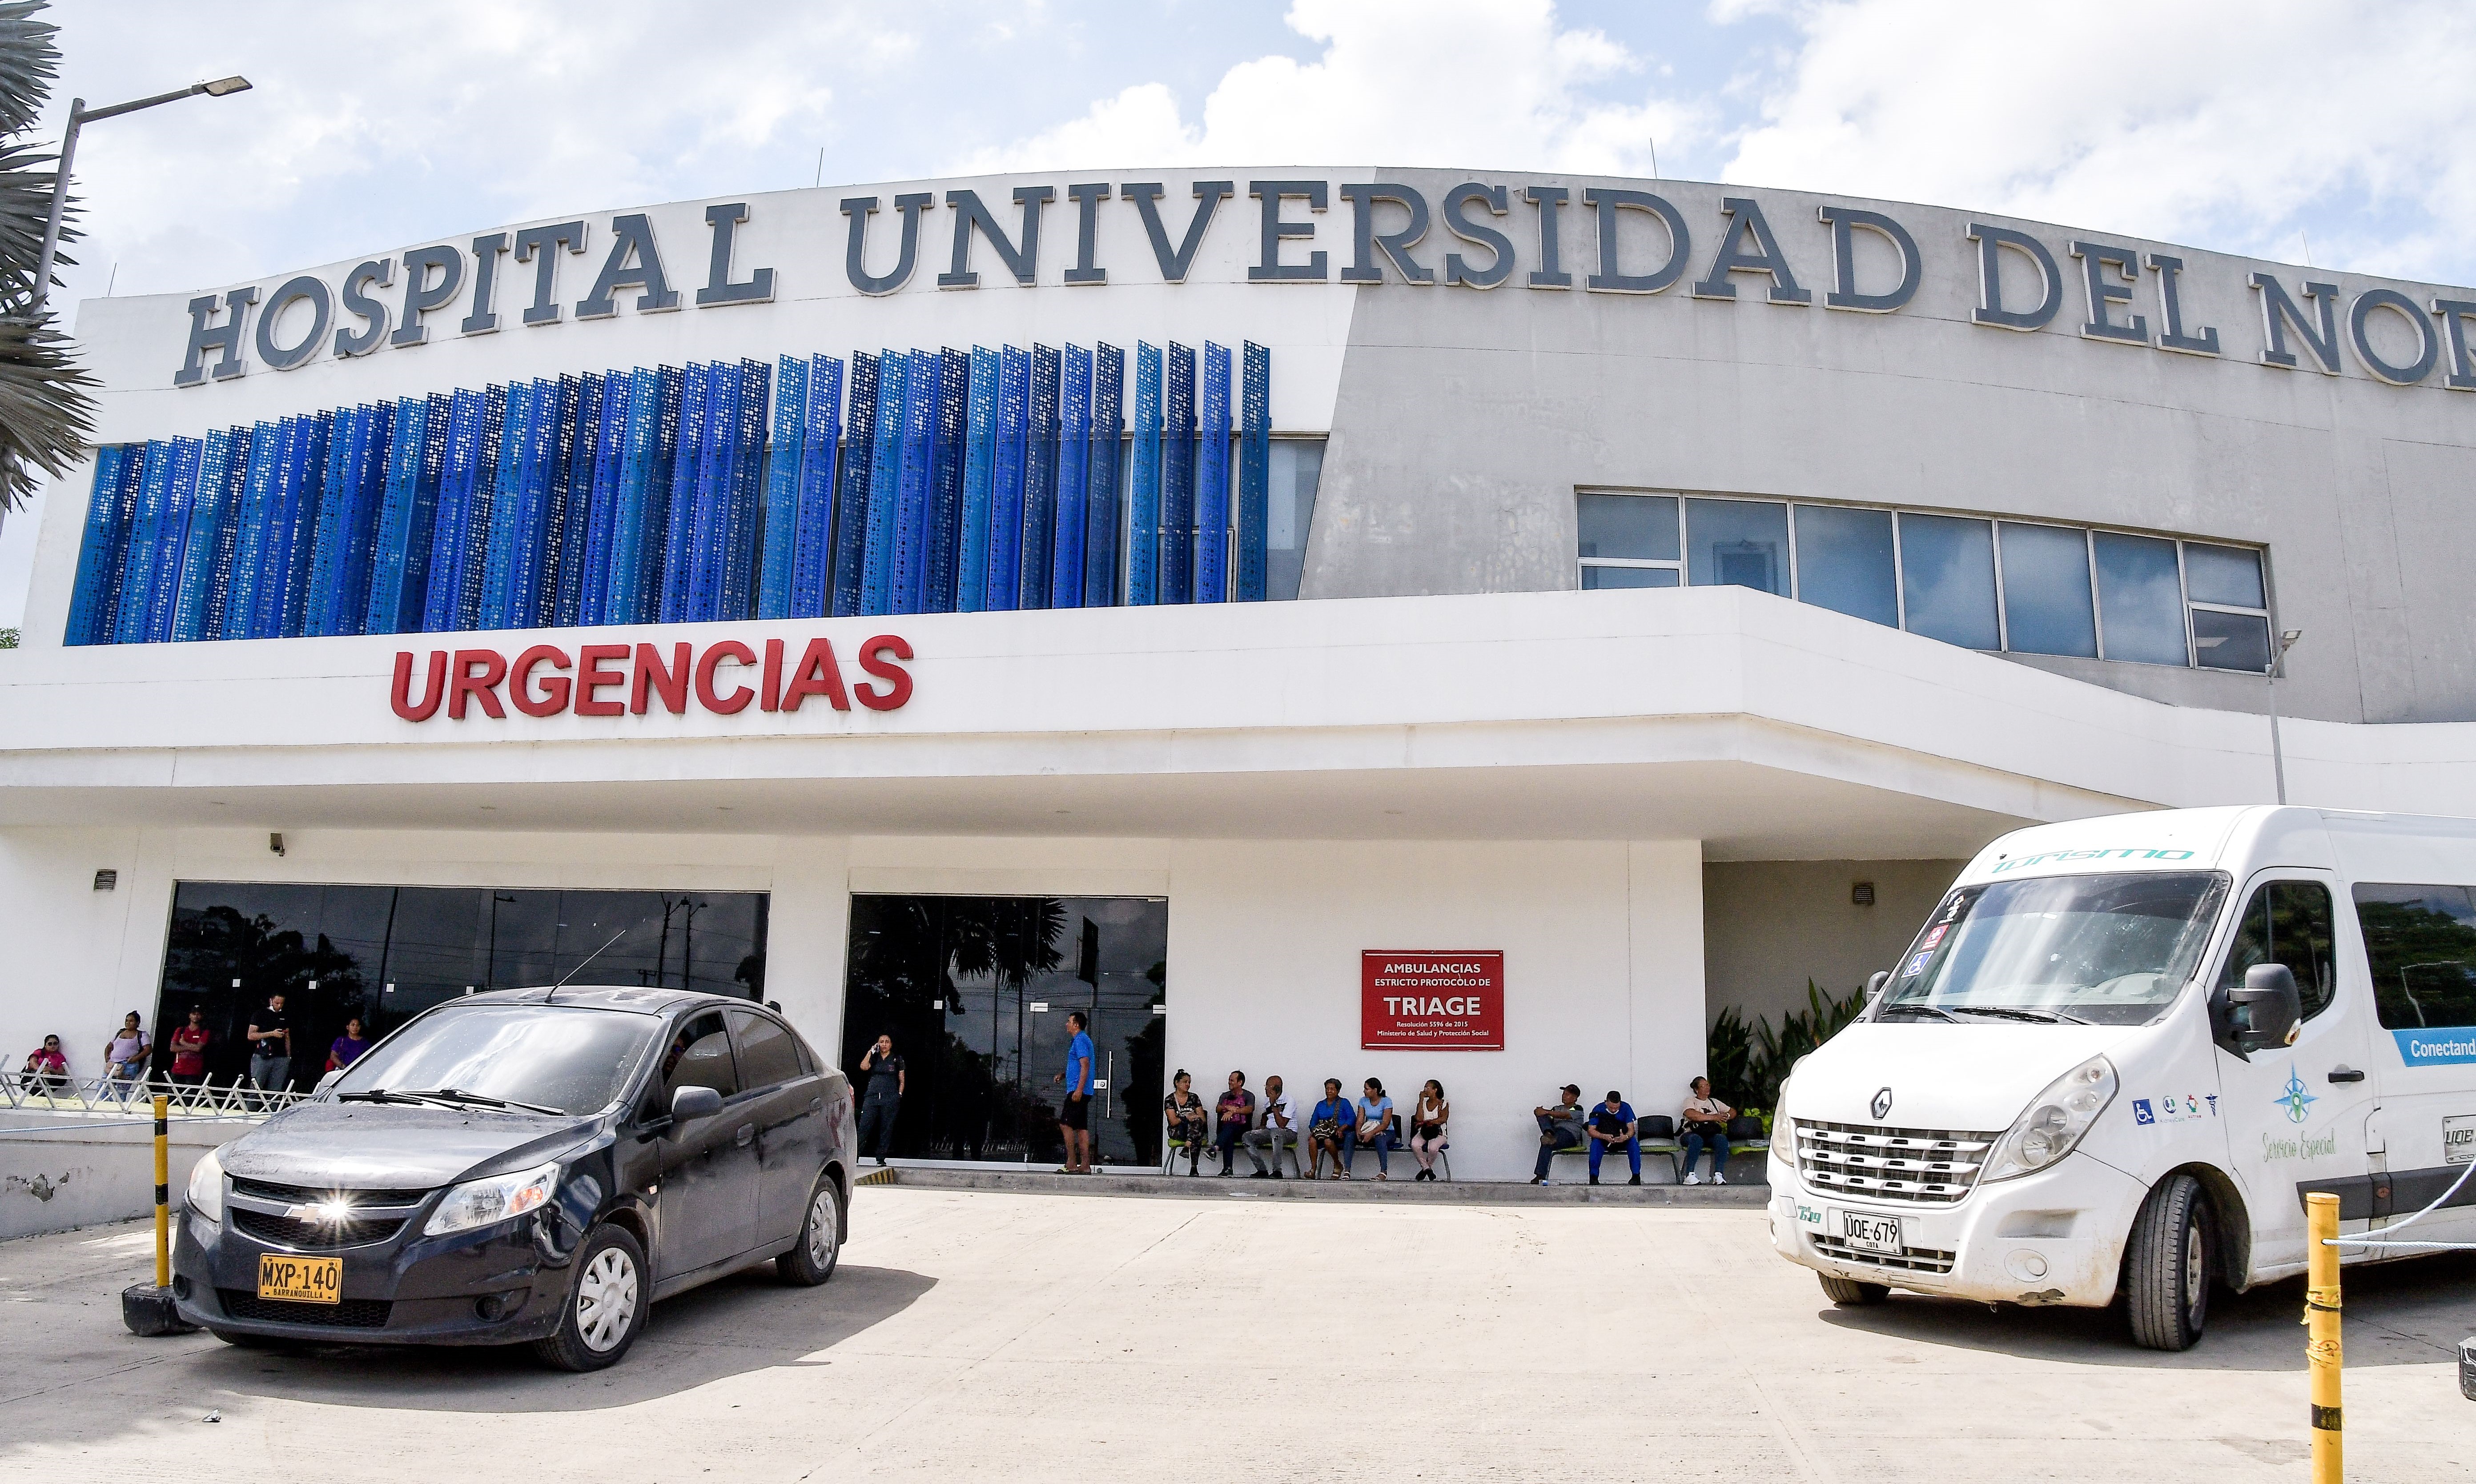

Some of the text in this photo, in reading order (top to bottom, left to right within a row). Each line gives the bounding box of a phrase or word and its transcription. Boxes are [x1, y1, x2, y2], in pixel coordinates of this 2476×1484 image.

[173, 203, 776, 388] HOSPITAL
[839, 180, 1923, 315] UNIVERSIDAD
[1965, 222, 2220, 357] DEL
[390, 634, 913, 722] URGENCIAS
[1384, 963, 1481, 973] AMBULANCIAS
[1383, 997, 1481, 1016] TRIAGE
[2301, 1128, 2335, 1163] Especial
